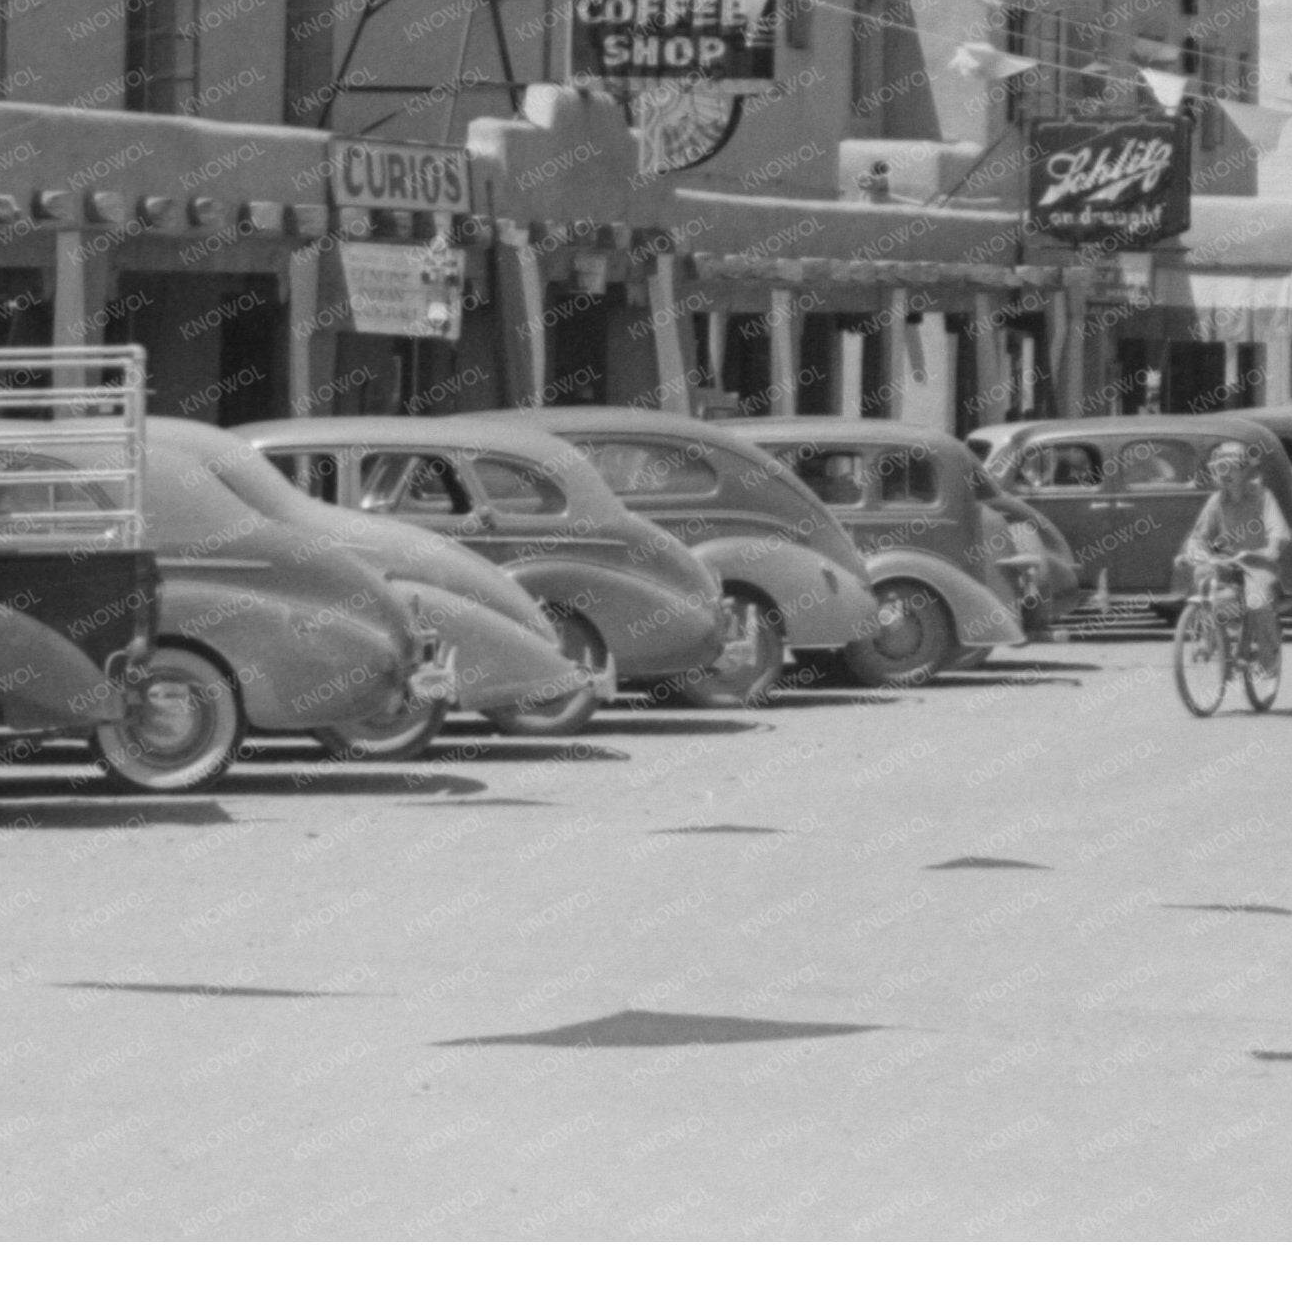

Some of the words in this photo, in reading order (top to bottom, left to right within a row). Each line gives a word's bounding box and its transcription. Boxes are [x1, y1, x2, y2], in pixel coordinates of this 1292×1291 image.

[602, 34, 727, 67] SHOP
[343, 145, 462, 204] CURIOS
[1038, 136, 1174, 207] Schlitz
[1049, 211, 1075, 226] on
